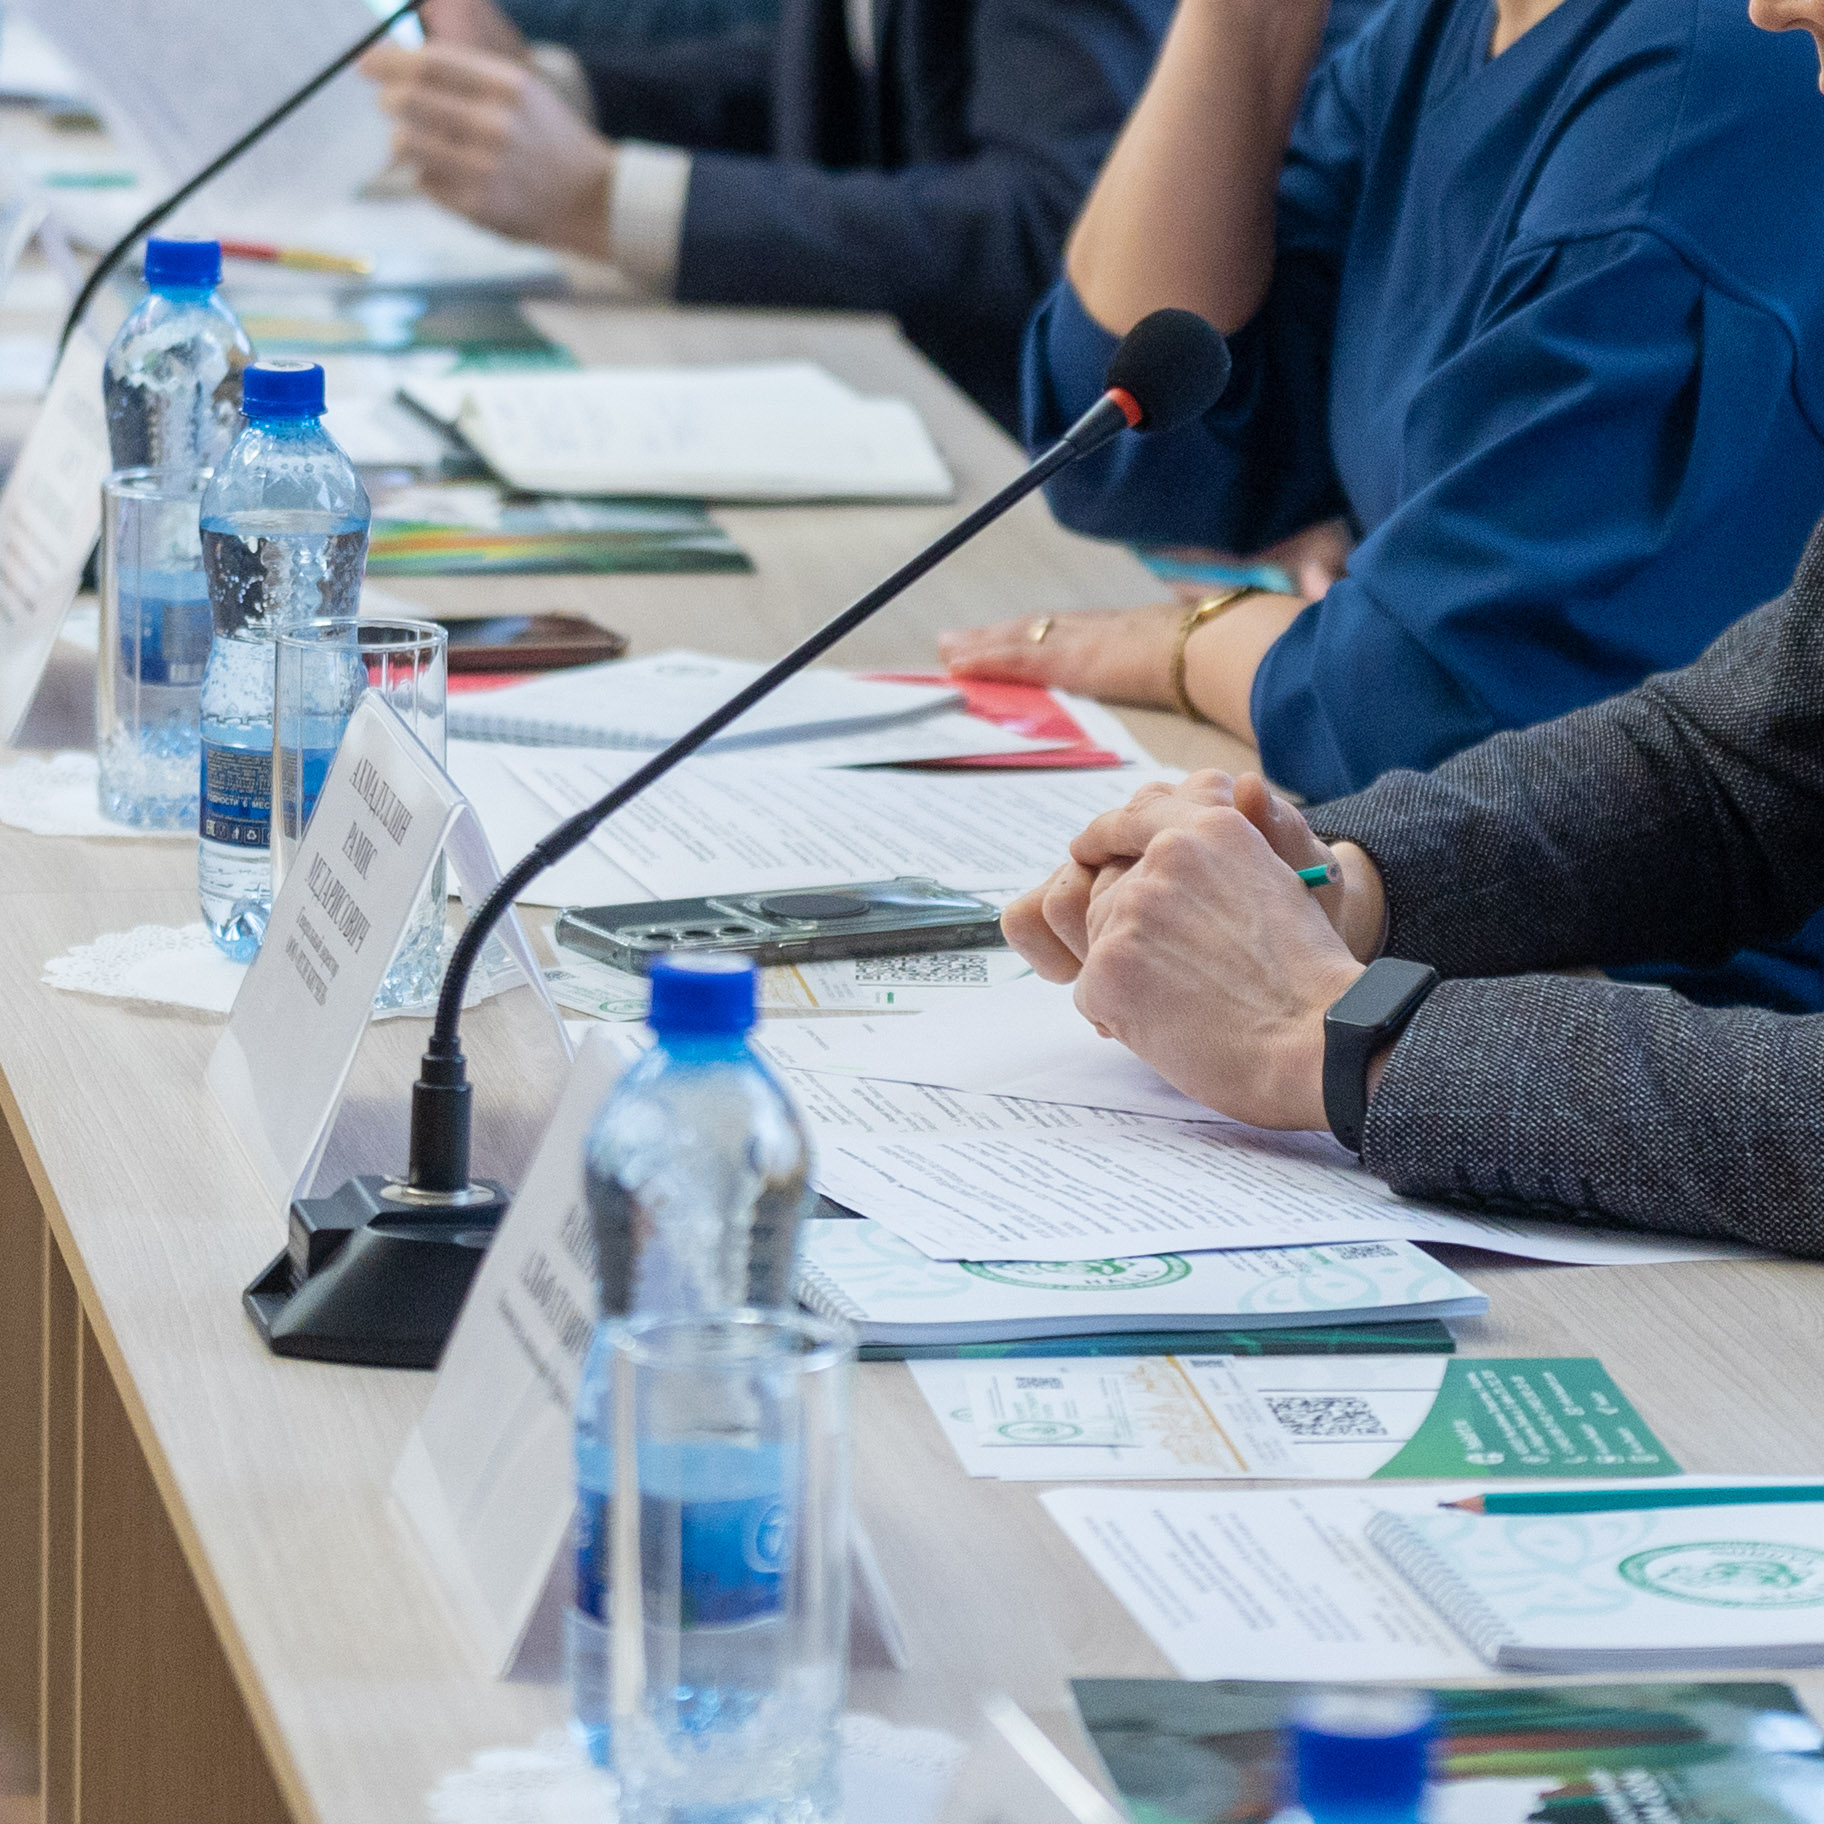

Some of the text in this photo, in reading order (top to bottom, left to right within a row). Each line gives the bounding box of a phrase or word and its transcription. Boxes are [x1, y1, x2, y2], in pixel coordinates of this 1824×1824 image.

[349, 757, 413, 846] АХМАДУЛЛИН
[341, 821, 379, 880] РАМИС
[304, 852, 371, 954] МЕДАРИСОВИЧ
